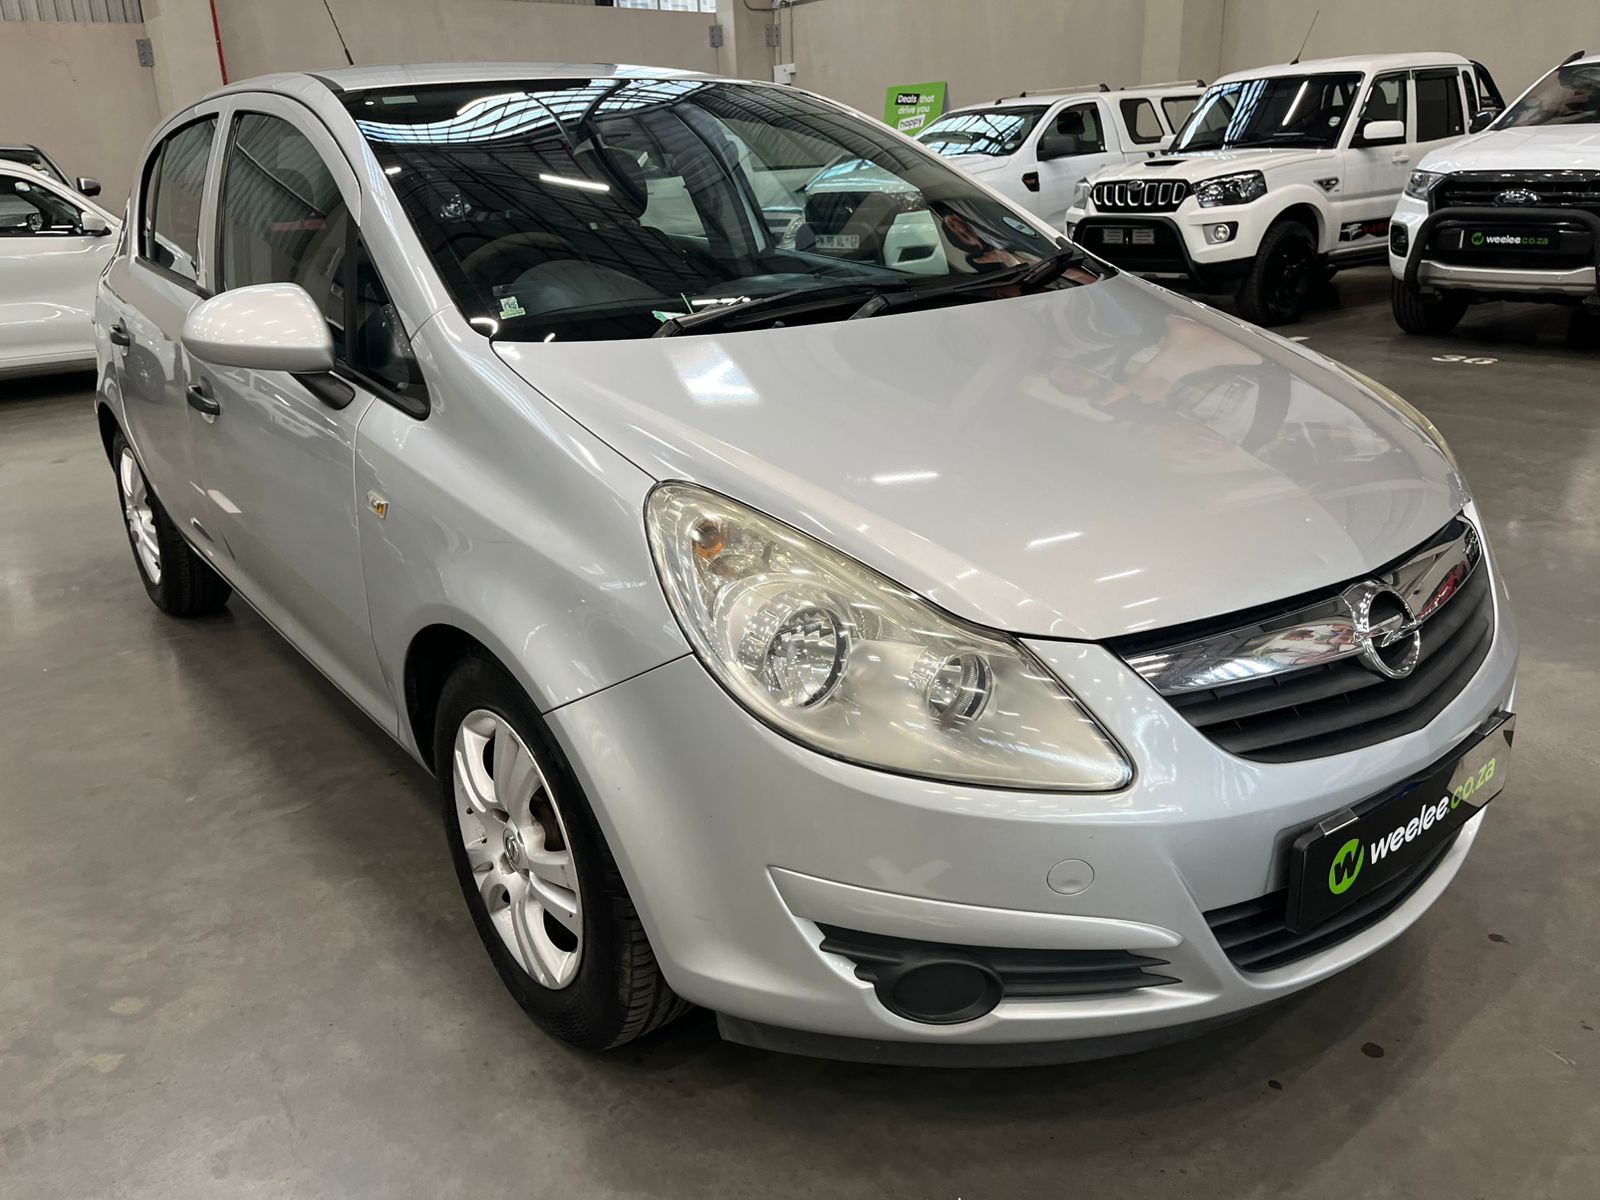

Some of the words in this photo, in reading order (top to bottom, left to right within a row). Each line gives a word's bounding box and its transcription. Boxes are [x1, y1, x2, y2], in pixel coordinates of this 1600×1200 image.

[897, 94, 917, 103] Deals
[920, 94, 935, 103] that
[898, 105, 916, 114] drive
[917, 106, 930, 115] you
[901, 117, 923, 128] happy
[1486, 235, 1549, 245] weelee.co.za
[1370, 757, 1496, 865] weelee.co.za
